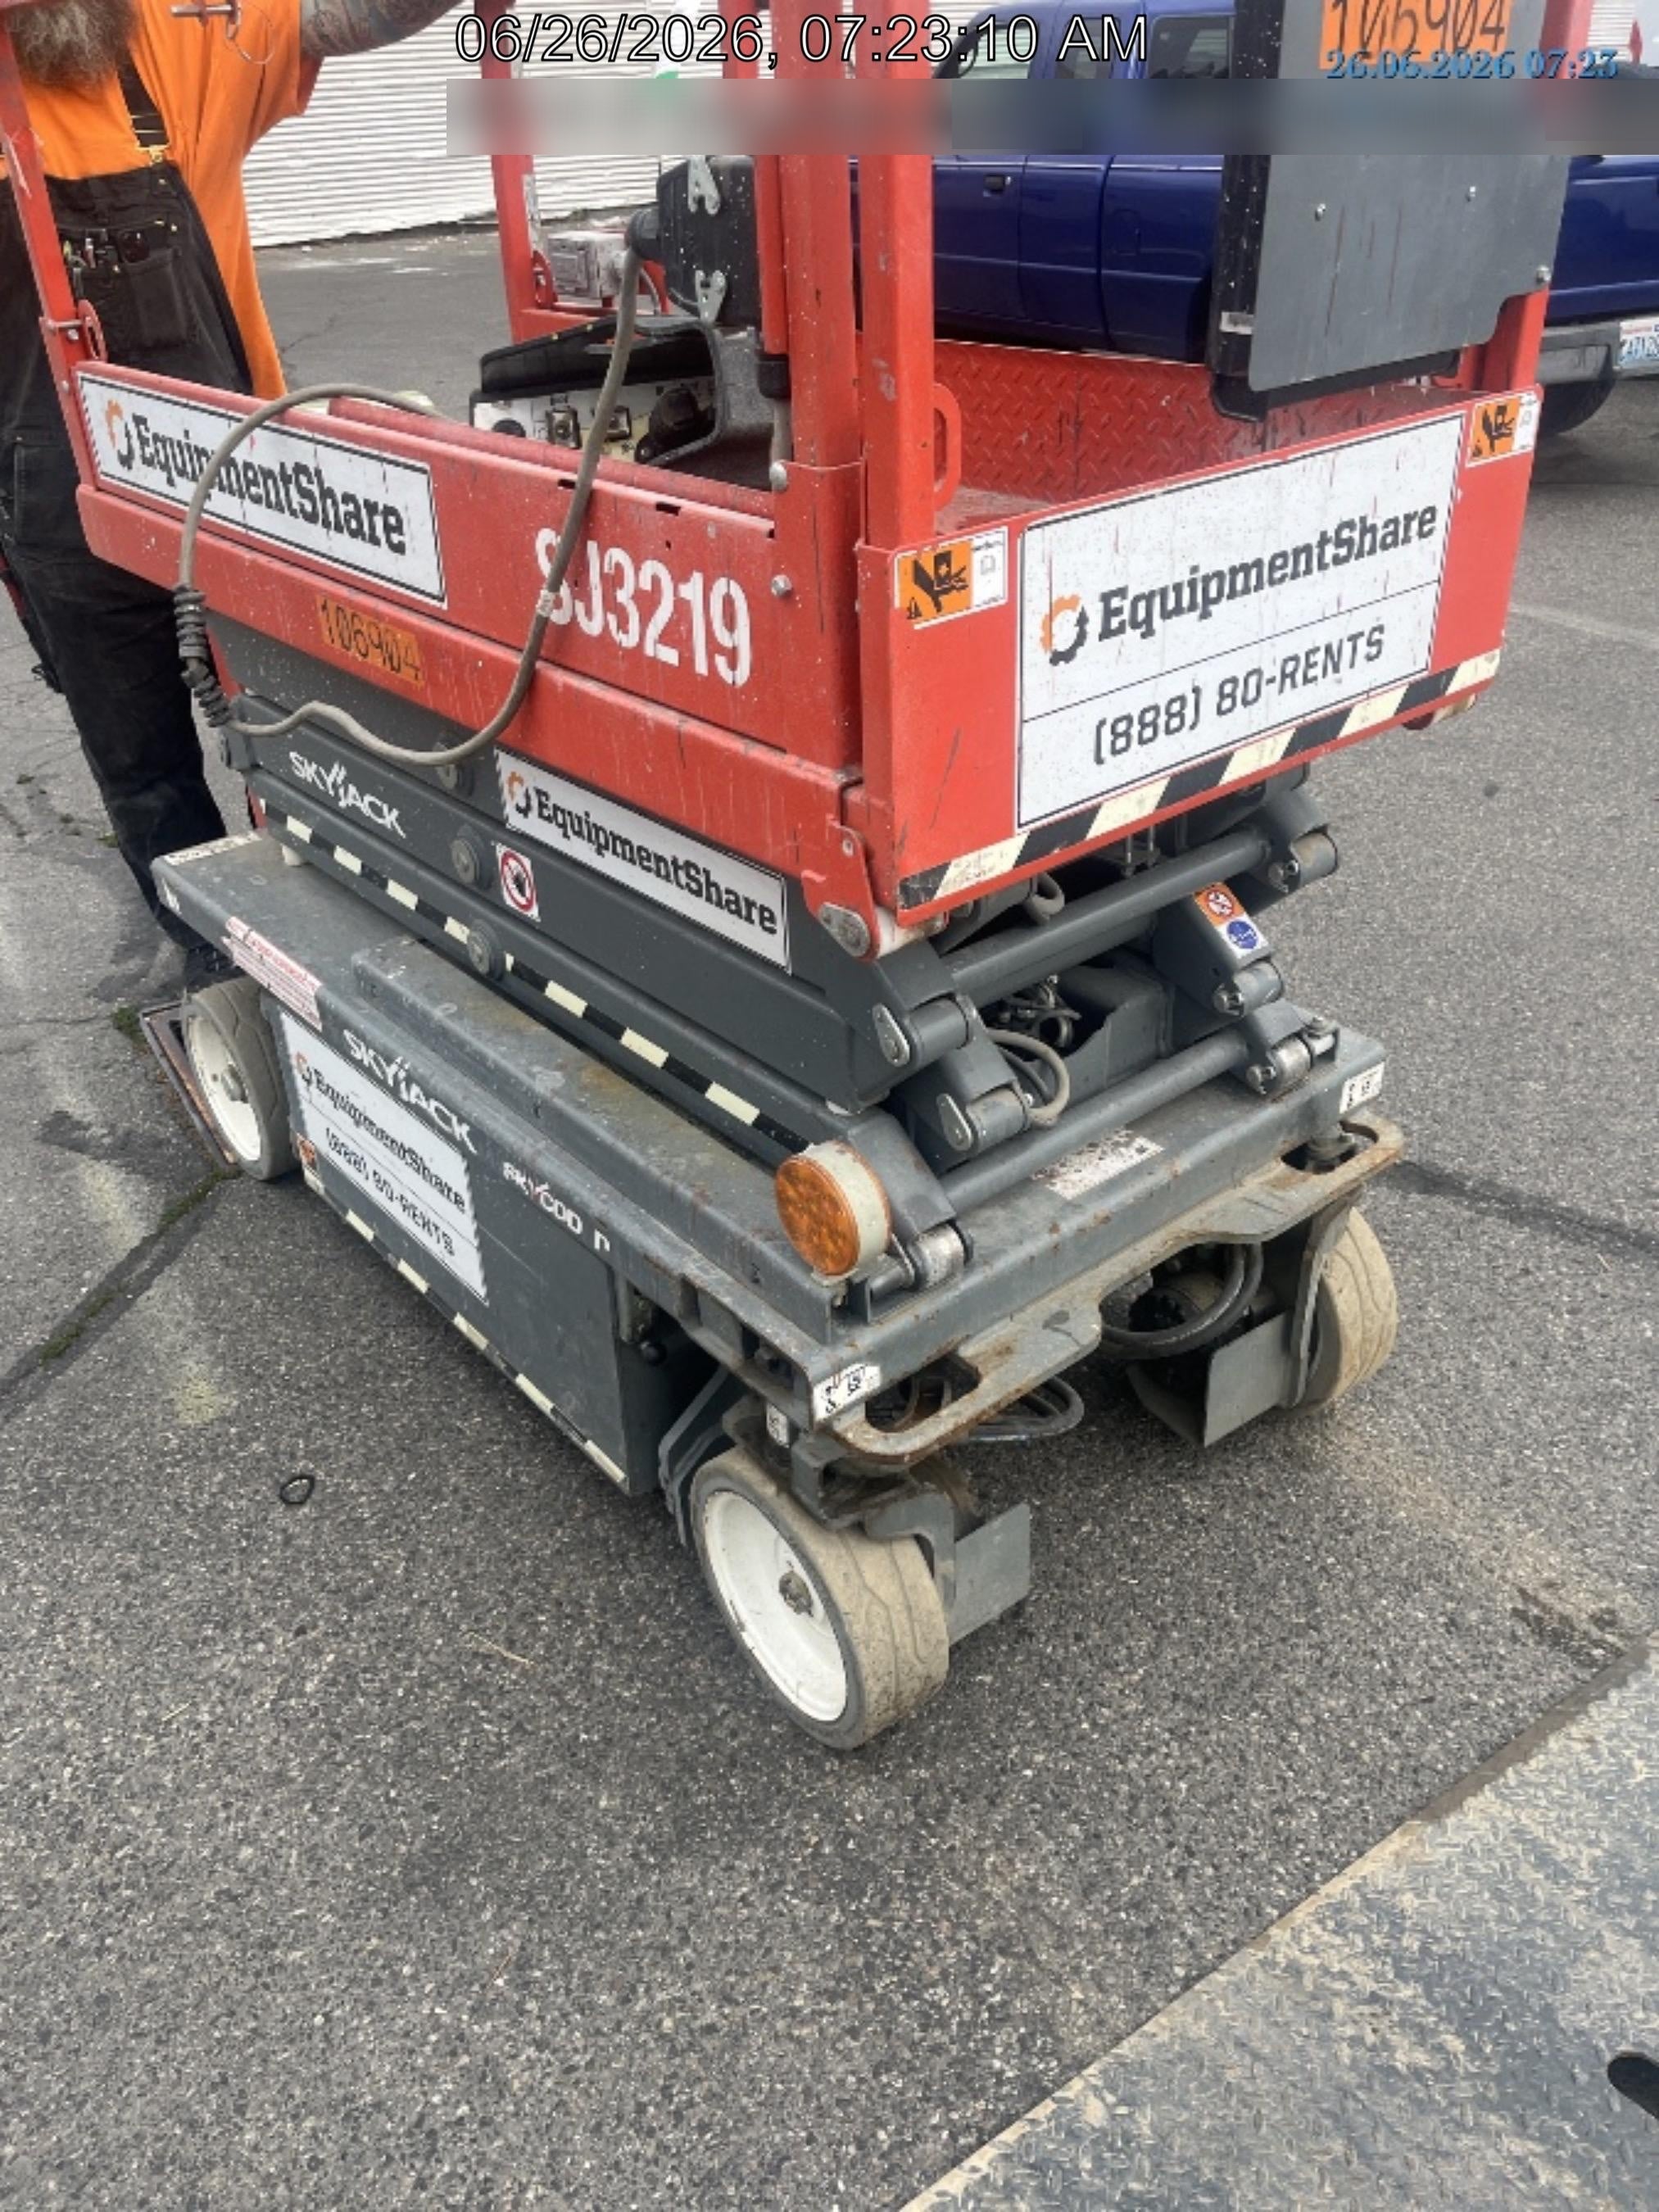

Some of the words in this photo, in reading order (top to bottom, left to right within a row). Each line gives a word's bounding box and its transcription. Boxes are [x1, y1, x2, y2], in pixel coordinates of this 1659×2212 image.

[535, 528, 752, 688] SJ3219
[1098, 505, 1438, 642] EquipmentShare
[1094, 685, 1202, 765] (888)
[1216, 624, 1385, 717] 80-RENTS
[289, 751, 406, 839] SKYJACK
[534, 786, 777, 936] EquipmentShare
[314, 1067, 466, 1214] EquipmentShare
[343, 1029, 478, 1155] SKYJACK
